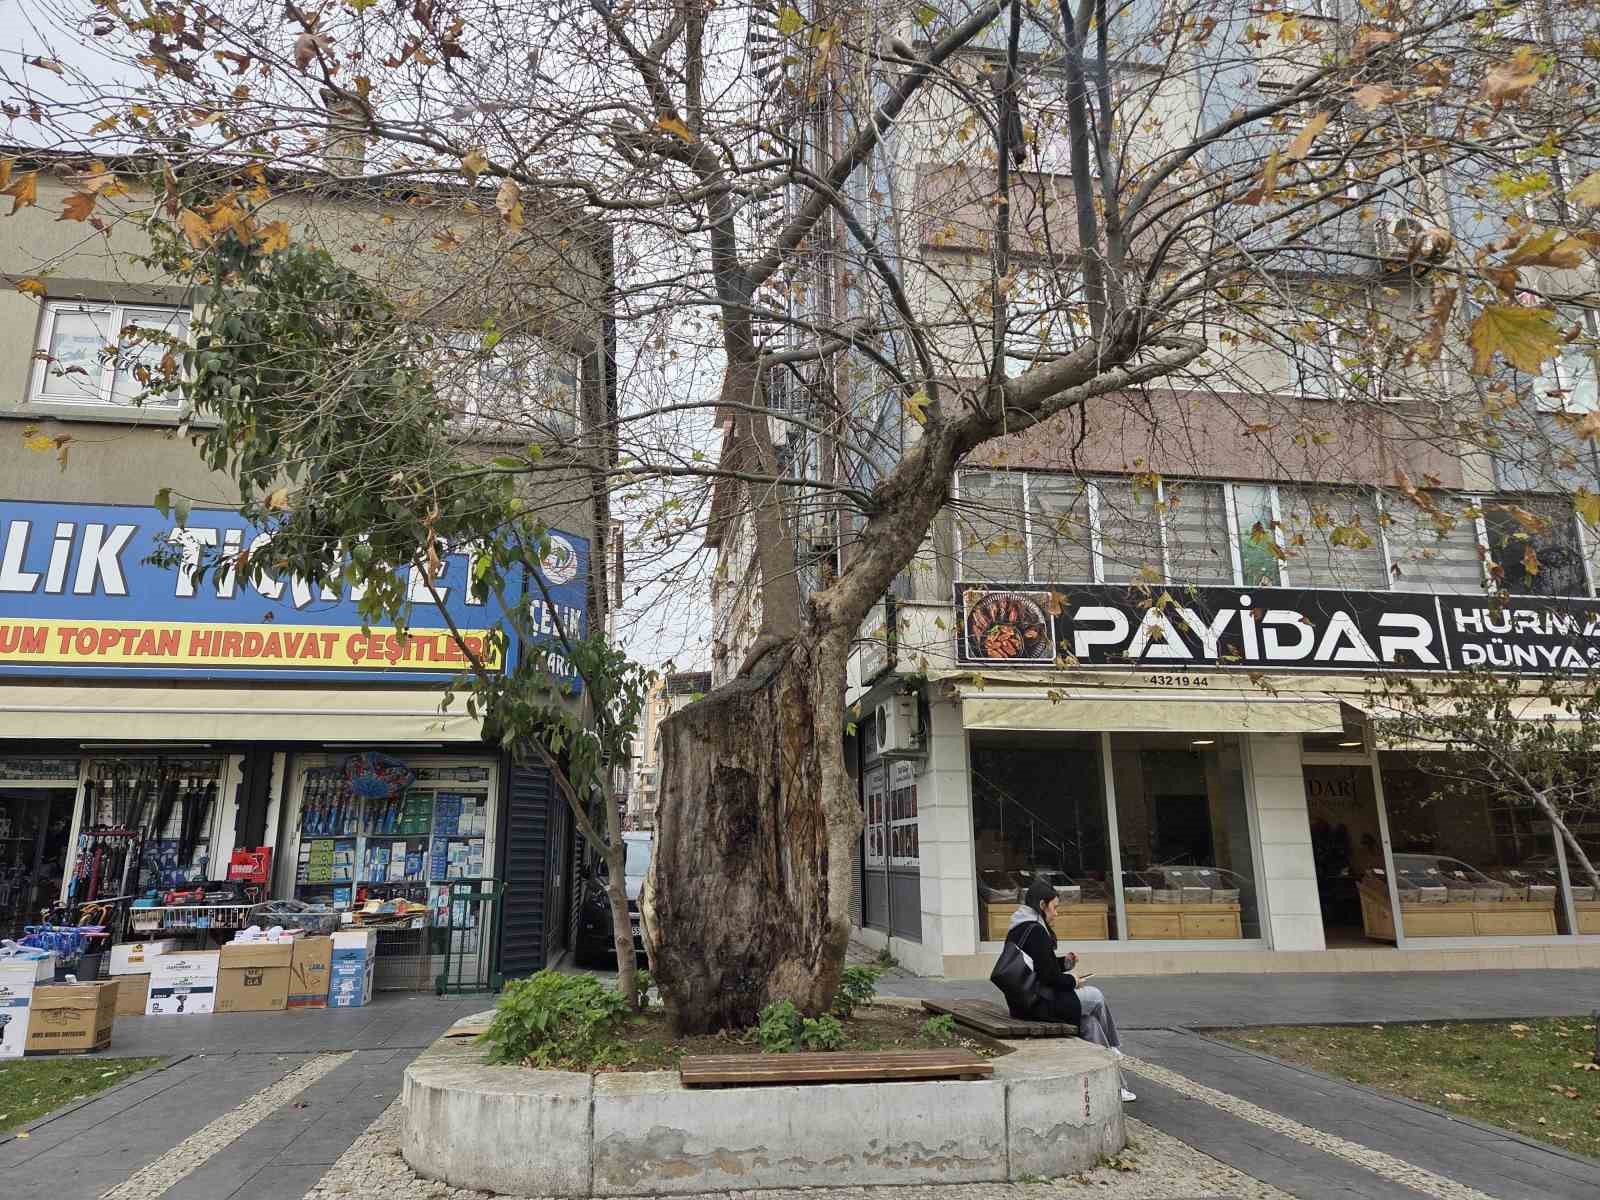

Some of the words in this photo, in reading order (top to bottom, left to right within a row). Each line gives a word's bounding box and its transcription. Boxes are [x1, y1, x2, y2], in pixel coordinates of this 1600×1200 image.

[57, 627, 181, 657] TOPTAN
[188, 629, 340, 659] HIRDAVAT
[1073, 595, 1440, 664] PAYİDAR
[1150, 675, 1173, 686] 432
[1175, 676, 1190, 687] 19
[1193, 677, 1209, 687] 44
